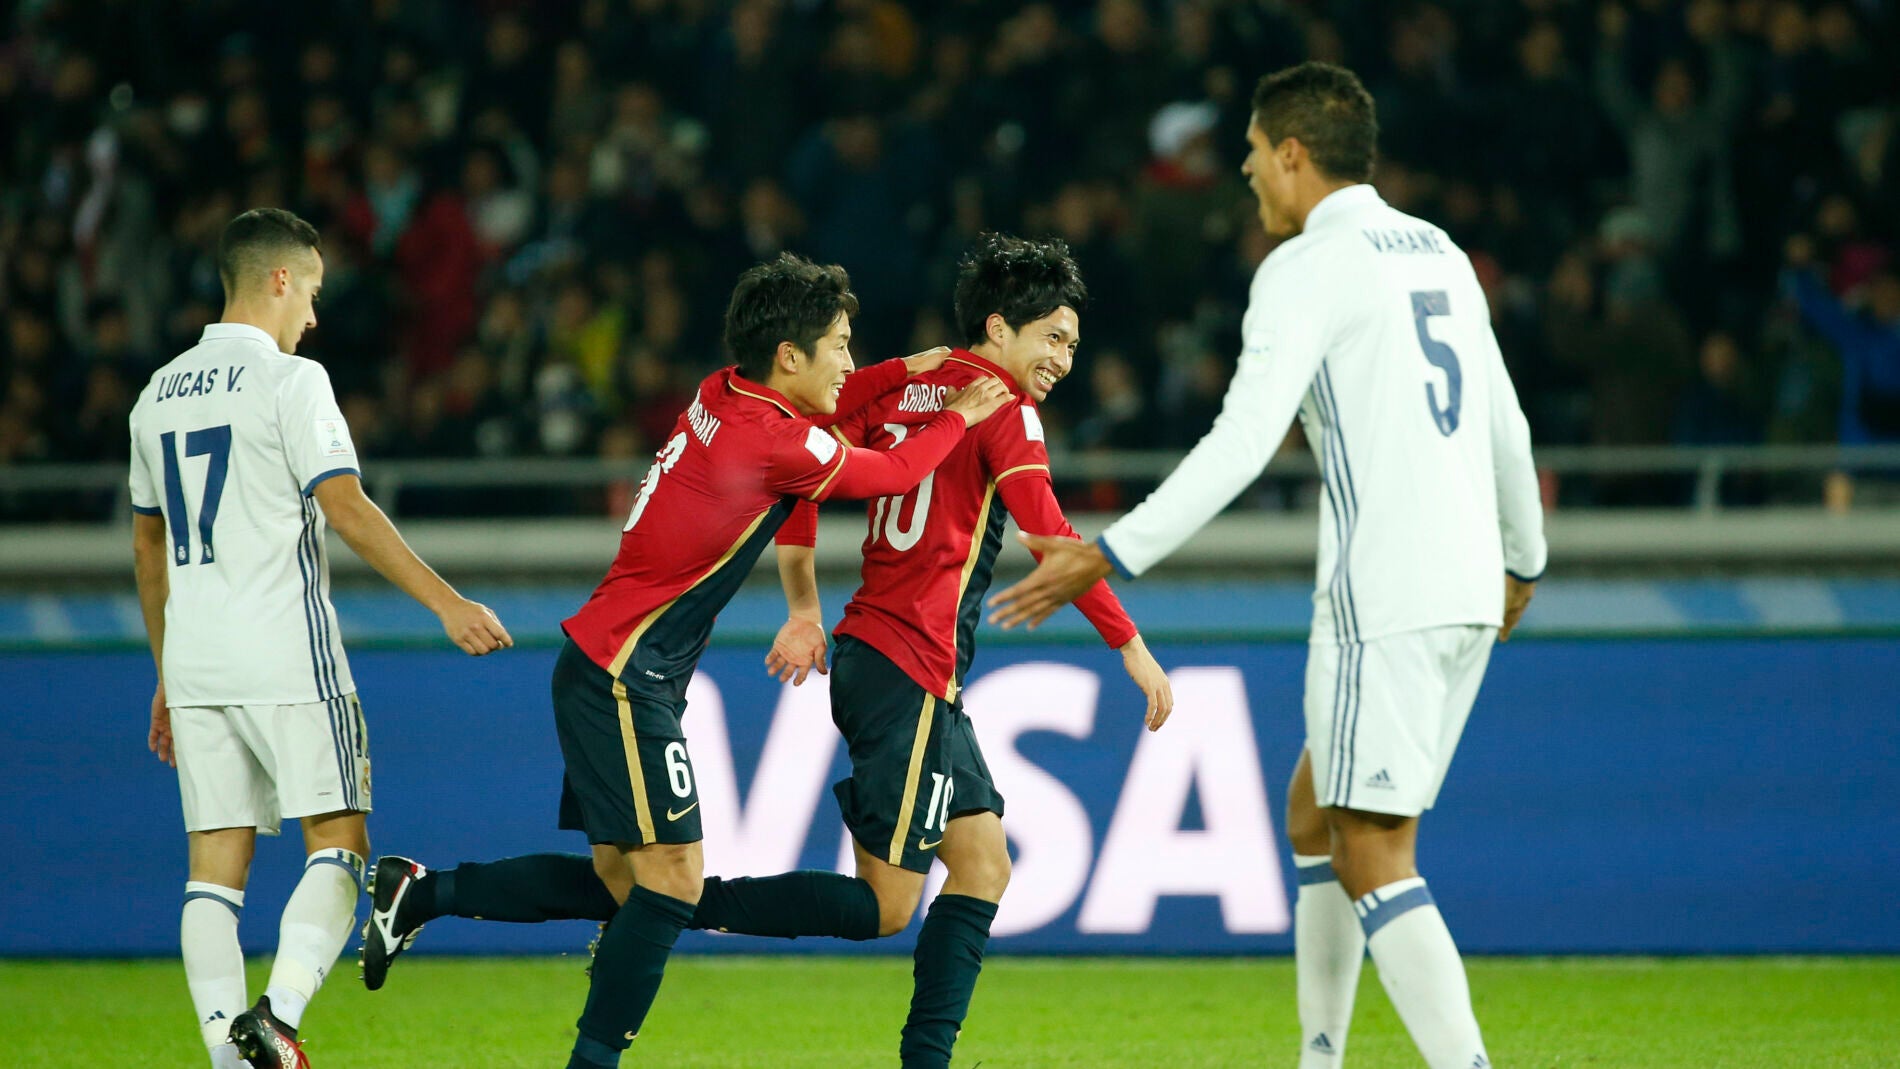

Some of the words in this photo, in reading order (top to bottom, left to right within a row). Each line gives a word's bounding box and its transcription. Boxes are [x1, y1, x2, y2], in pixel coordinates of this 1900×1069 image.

[1362, 229, 1446, 254] VARANE
[156, 368, 219, 402] LUCAS
[227, 366, 245, 392] V.
[1409, 289, 1463, 438] 5
[898, 384, 948, 412] SHIBAS
[160, 424, 232, 566] 17
[665, 741, 692, 798] 6
[684, 662, 1292, 935] VSA
[924, 772, 955, 833] 10
[274, 1037, 292, 1069] adida
